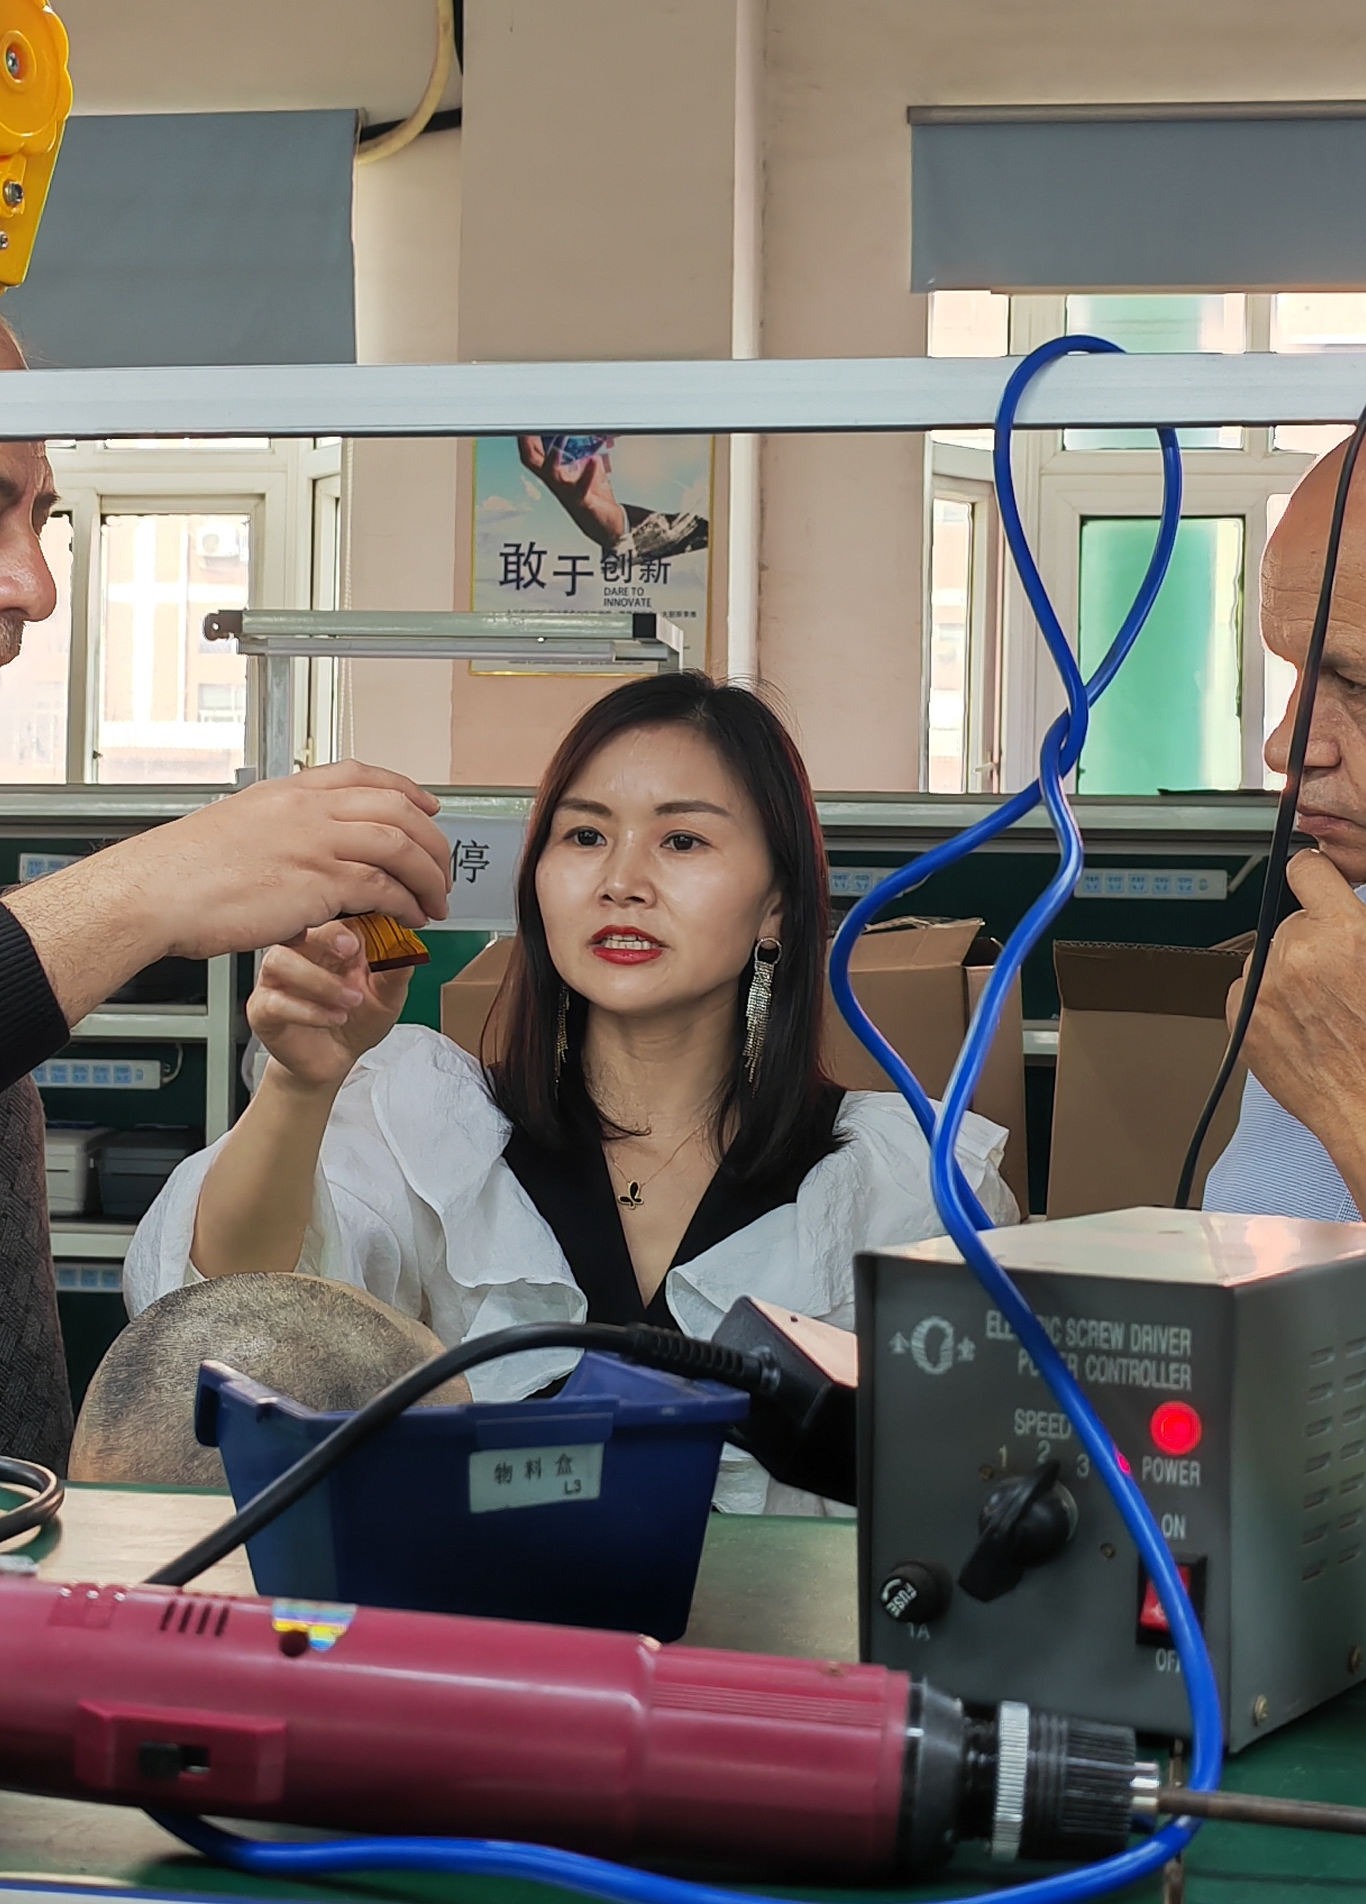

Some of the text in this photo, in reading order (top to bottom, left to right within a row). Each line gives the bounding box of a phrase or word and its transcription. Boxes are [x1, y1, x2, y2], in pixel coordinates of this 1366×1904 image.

[603, 587, 644, 597] DARE TO
[603, 598, 651, 608] INNOVATE
[450, 839, 490, 883] 停
[1066, 1318, 1126, 1350] SCREW
[1130, 1323, 1192, 1357] DRIVER
[1086, 1354, 1192, 1391] CONTROLLER
[1014, 1408, 1072, 1439] SPEED
[494, 1453, 573, 1485] 物料盒
[998, 1440, 1090, 1479] 1 2 3
[1142, 1456, 1201, 1487] POWER
[1161, 1513, 1186, 1540] ON
[885, 1582, 917, 1618] FUSE
[908, 1621, 930, 1640] 1A
